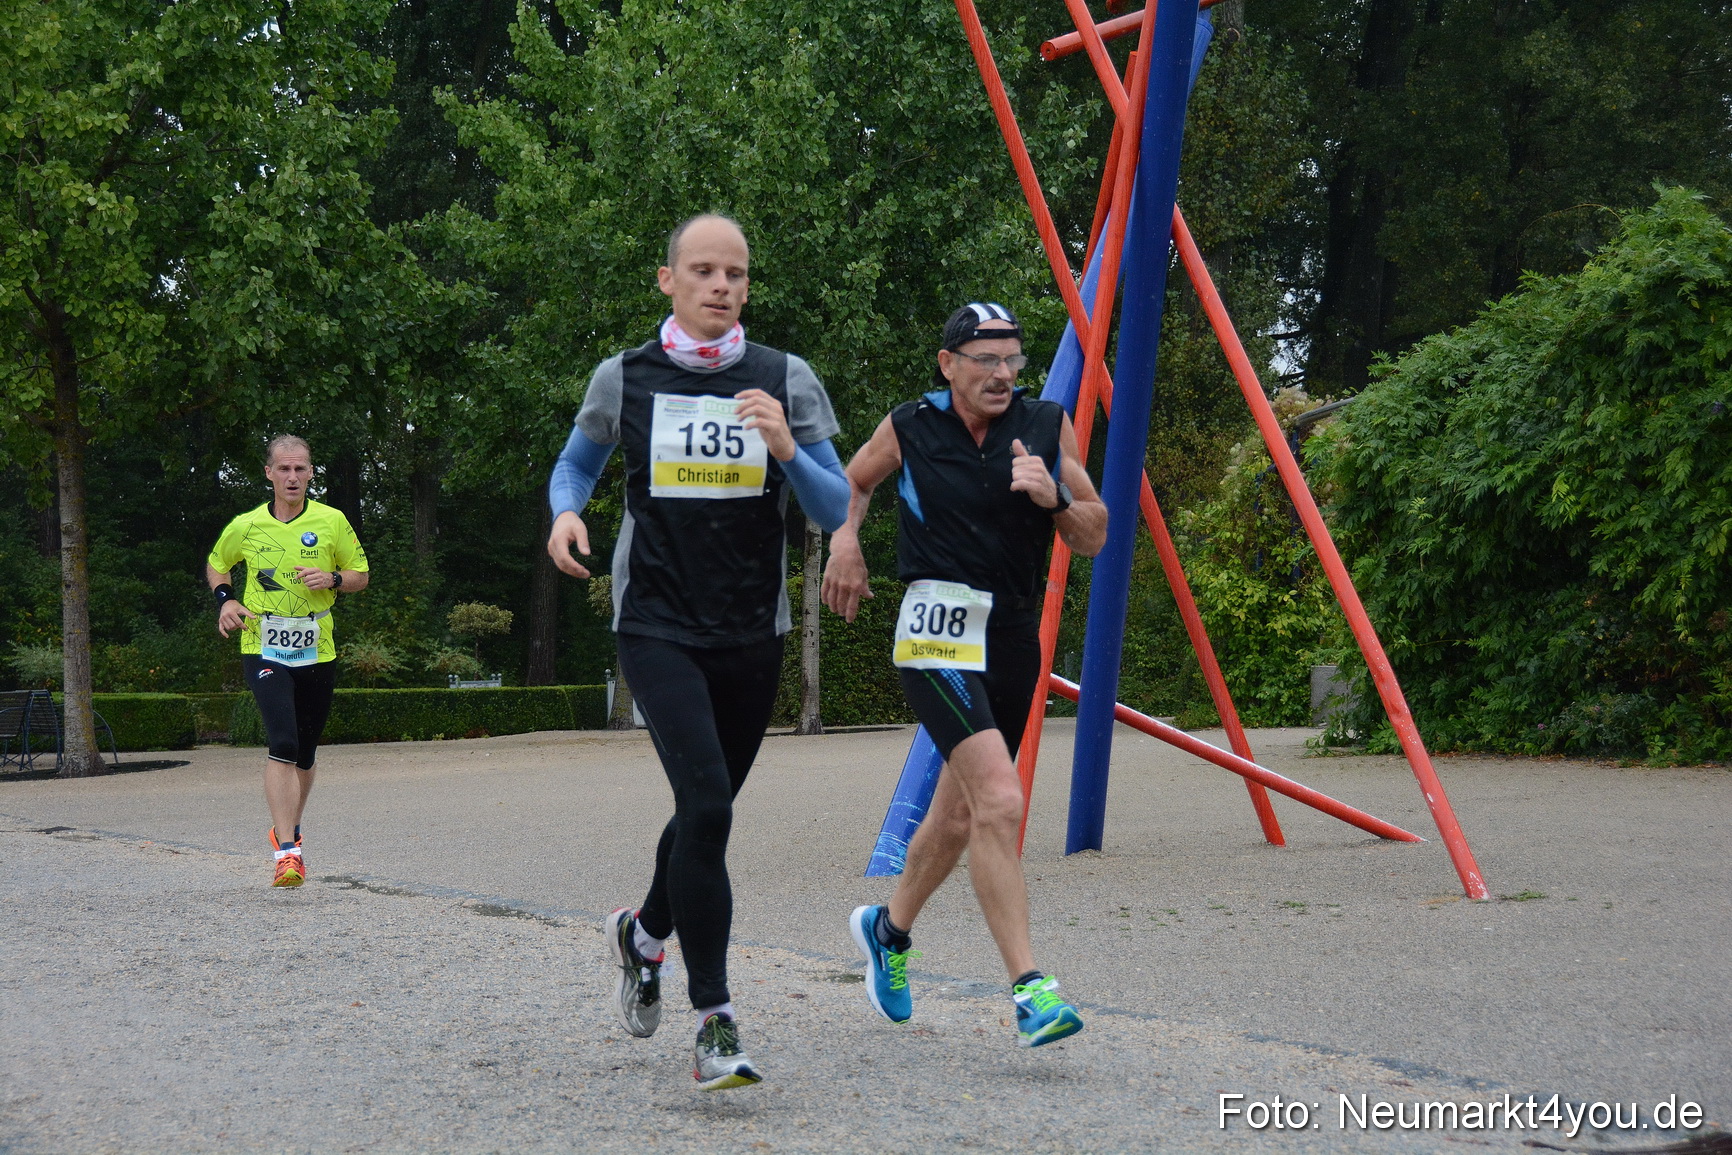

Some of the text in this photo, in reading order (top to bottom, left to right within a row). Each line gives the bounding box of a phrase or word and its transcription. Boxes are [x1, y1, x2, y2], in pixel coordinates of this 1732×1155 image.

[679, 421, 744, 459] 135
[677, 467, 740, 484] Christian
[909, 602, 968, 638] 308
[267, 628, 315, 649] 2828
[275, 651, 305, 661] Helmuth
[911, 642, 956, 659] Oswald
